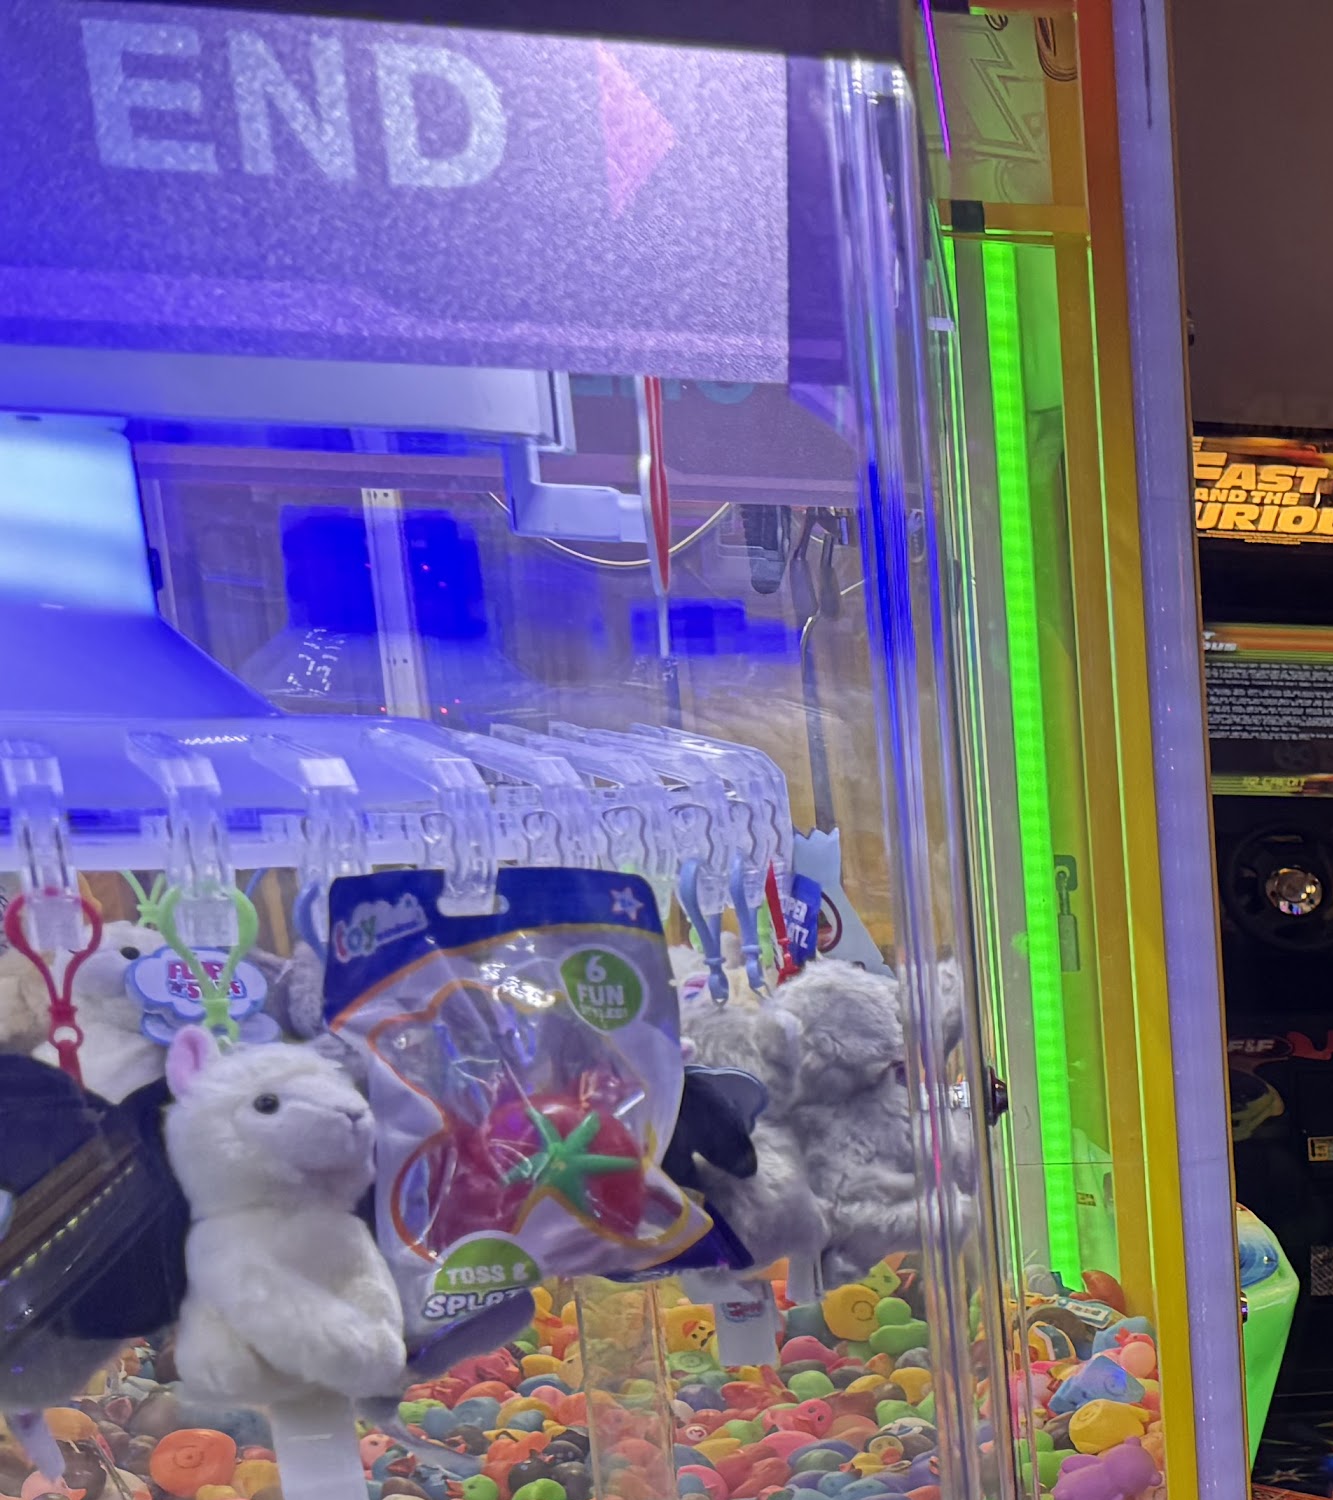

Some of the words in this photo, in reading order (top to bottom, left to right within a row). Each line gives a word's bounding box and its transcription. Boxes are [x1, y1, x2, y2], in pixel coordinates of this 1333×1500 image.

[80, 17, 508, 190] END
[1250, 490, 1302, 506] THE
[584, 957, 608, 983] 6
[576, 983, 626, 1009] FUN
[446, 1263, 506, 1286] TOSS
[511, 1261, 529, 1281] &
[423, 1285, 520, 1320] SPLA
